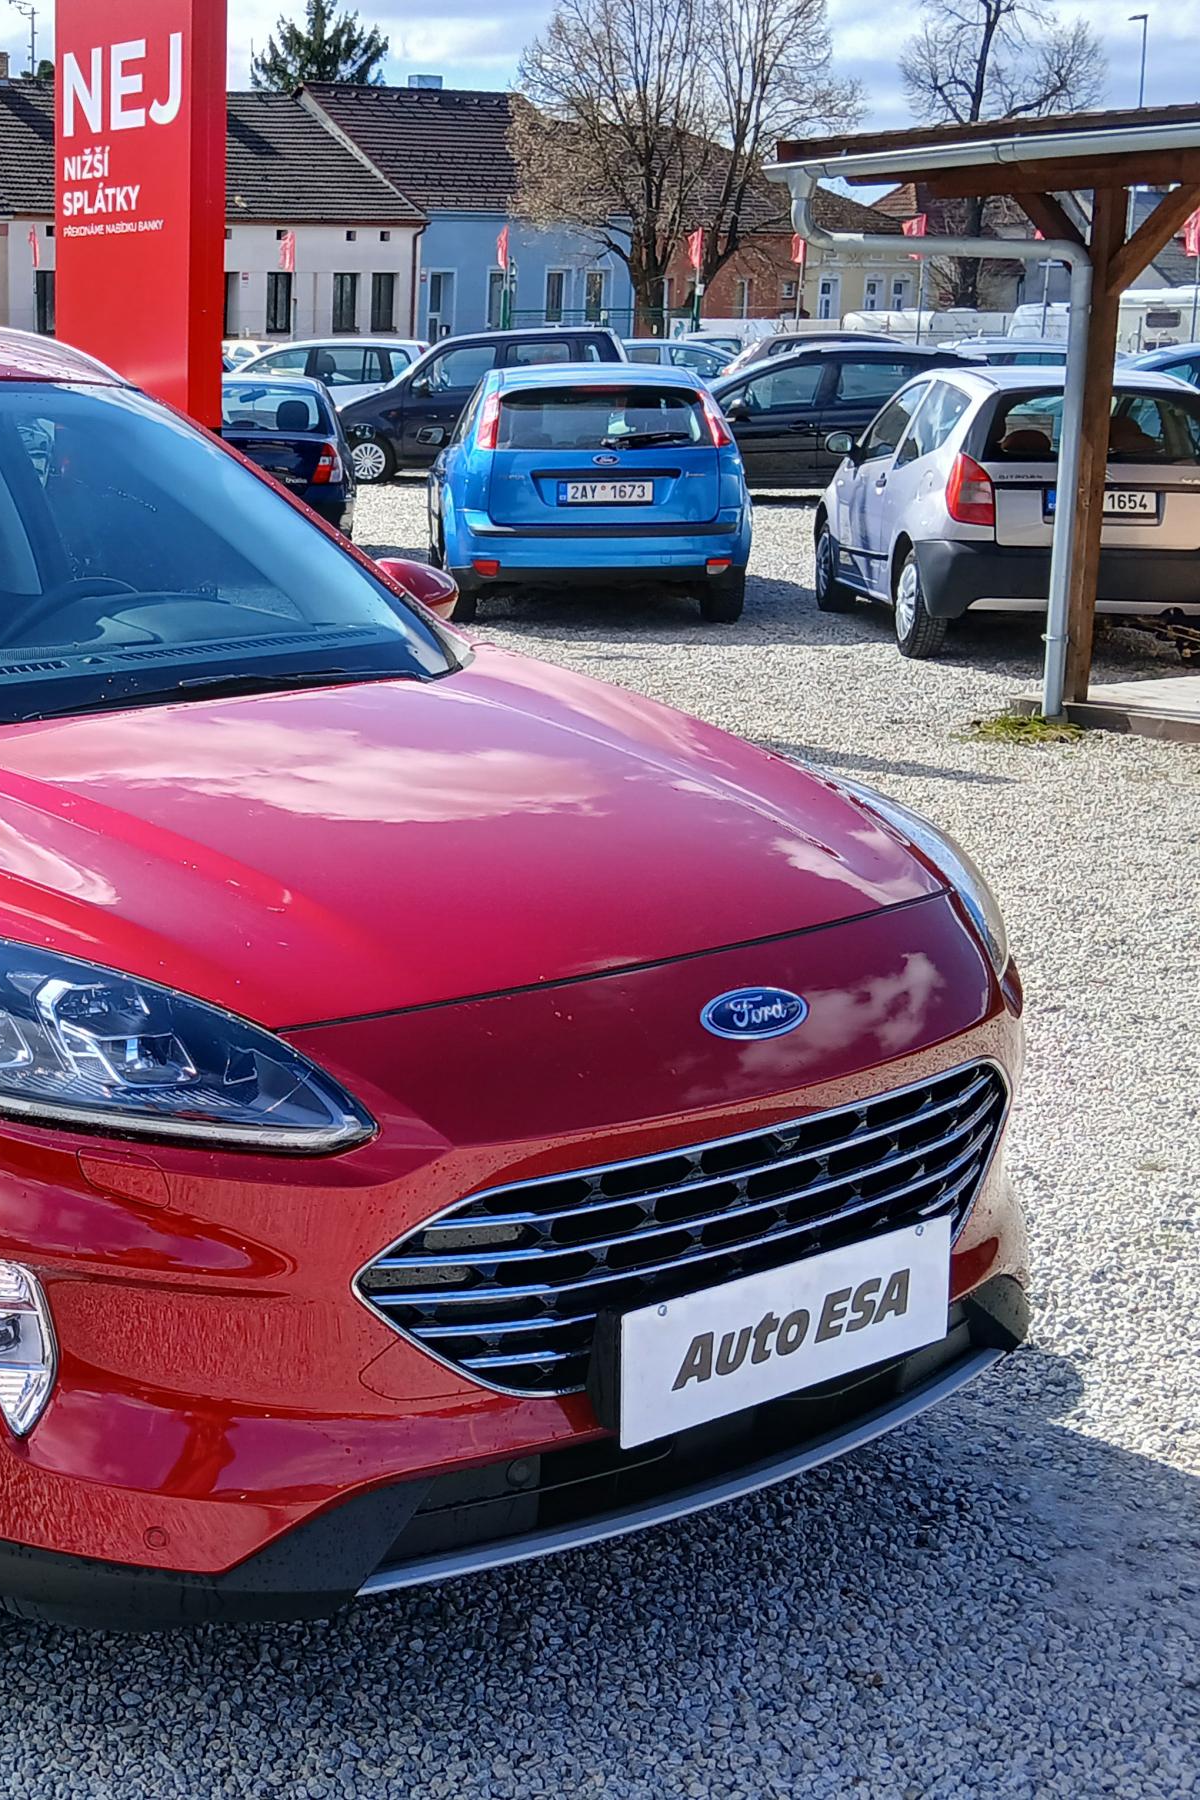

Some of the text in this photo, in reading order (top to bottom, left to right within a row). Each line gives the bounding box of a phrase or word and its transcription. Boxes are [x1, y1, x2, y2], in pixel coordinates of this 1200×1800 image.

[62, 32, 183, 138] NEJ
[63, 145, 111, 181] NIŽŠÍ
[62, 182, 141, 217] SPLÁTKY
[138, 219, 164, 232] BANKY
[570, 484, 646, 500] 2AY 1673
[1107, 493, 1148, 511] 1654
[728, 994, 788, 1028] Ford
[671, 1267, 911, 1392] Auto ESA
